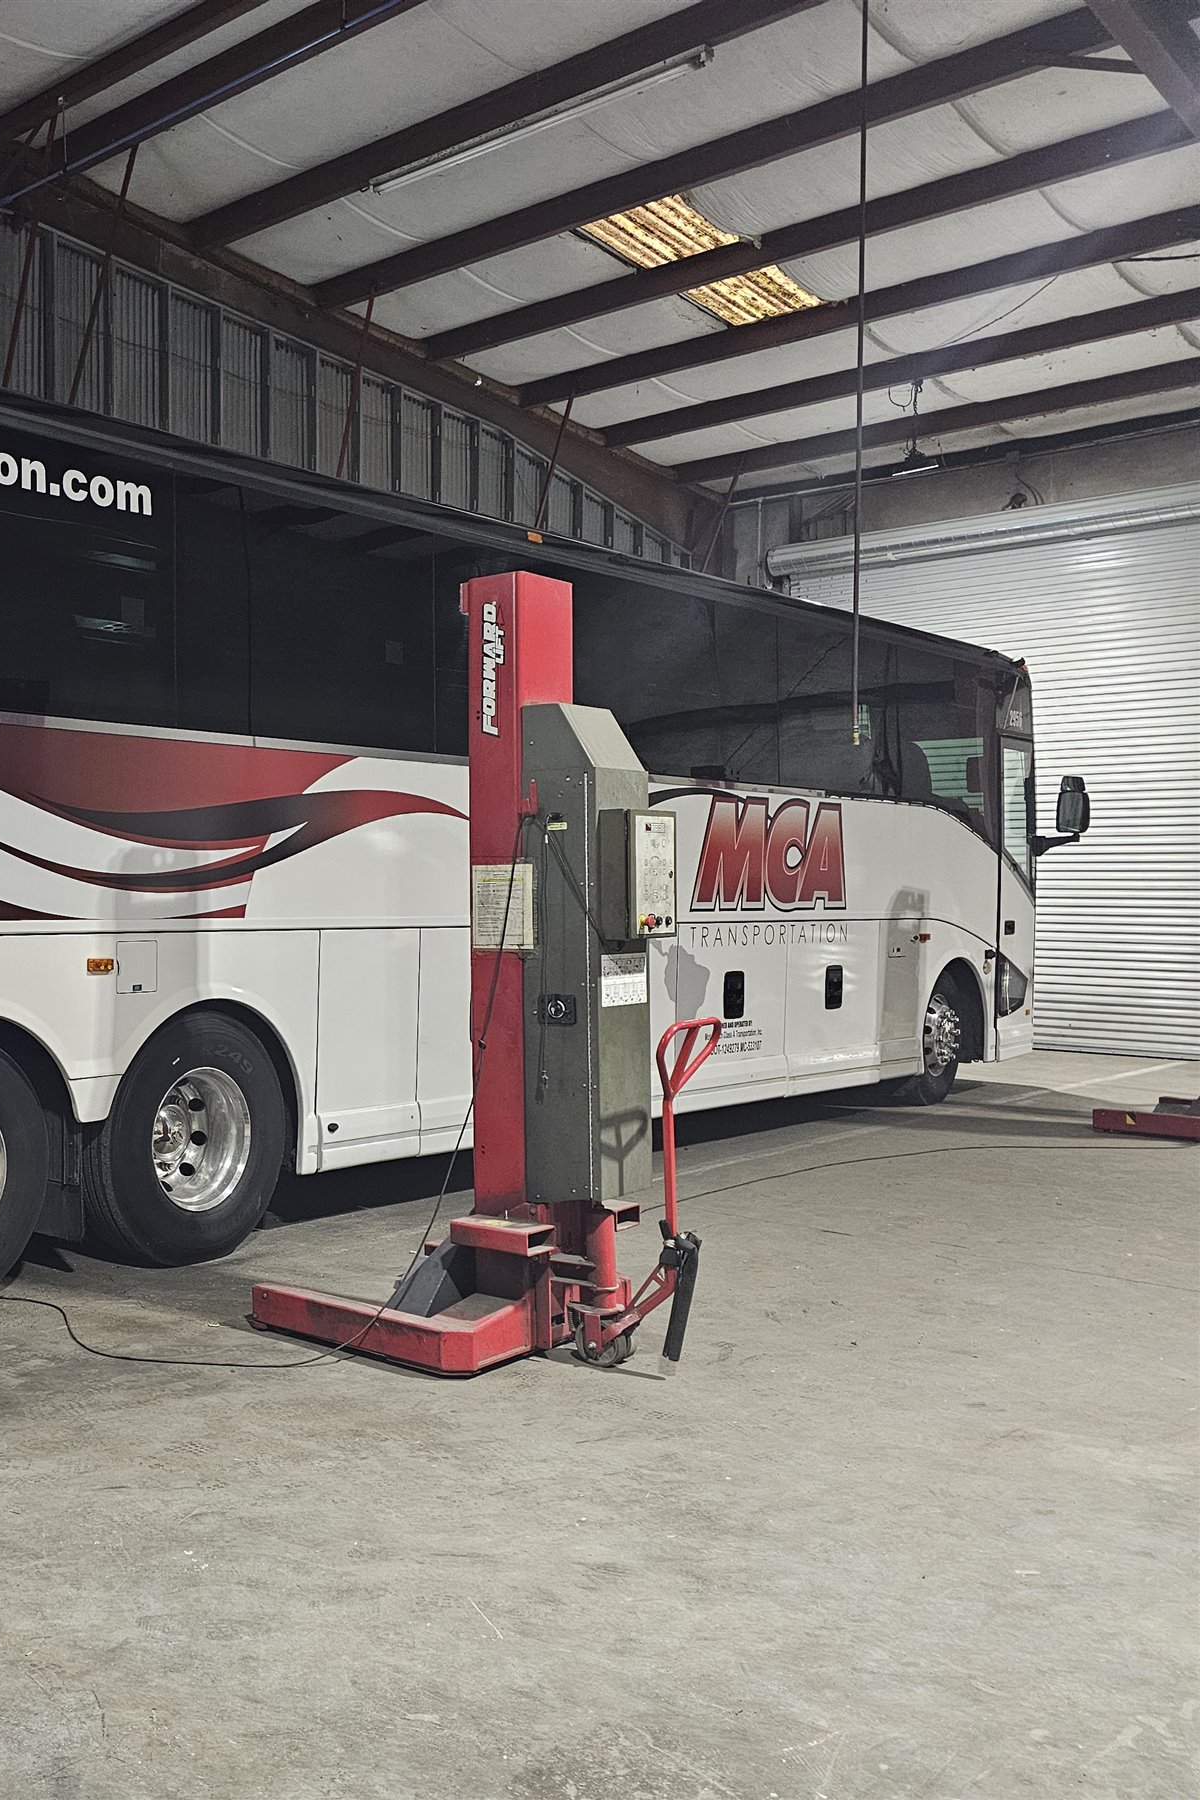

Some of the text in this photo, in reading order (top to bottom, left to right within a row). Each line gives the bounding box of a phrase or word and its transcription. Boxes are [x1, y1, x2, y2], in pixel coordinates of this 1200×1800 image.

[482, 601, 499, 737] FORWARD
[495, 625, 505, 665] LIFT
[689, 795, 847, 912] MCA
[690, 923, 848, 948] TRANSPORTATION
